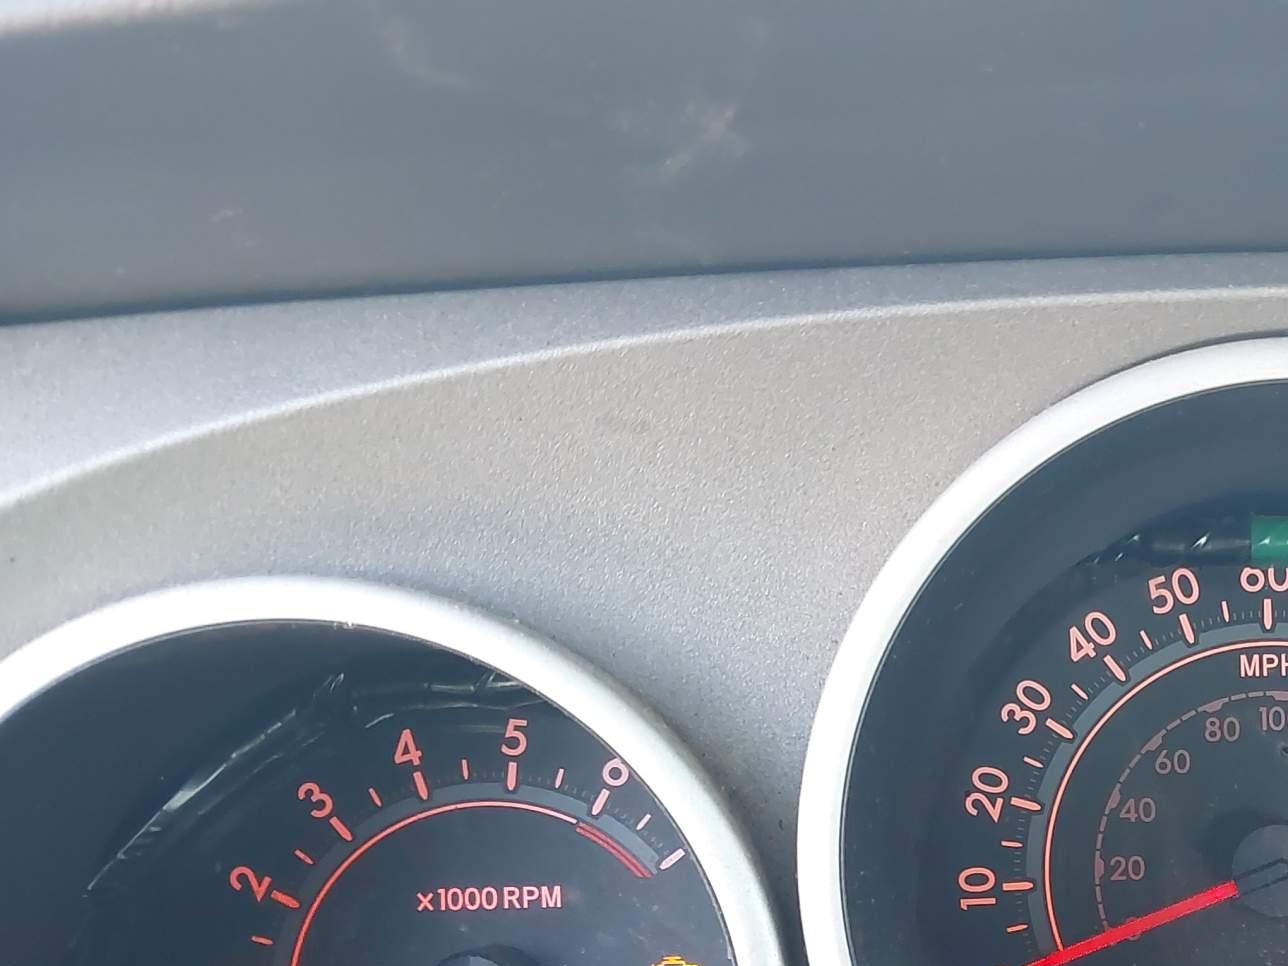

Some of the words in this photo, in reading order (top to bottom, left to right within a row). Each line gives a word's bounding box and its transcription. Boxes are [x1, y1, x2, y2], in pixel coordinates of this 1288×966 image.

[1148, 567, 1201, 616] 50
[1068, 611, 1118, 665] 40
[1001, 679, 1053, 736] 30
[393, 729, 422, 766] 4
[502, 719, 528, 756] 5
[1204, 718, 1241, 742] 80
[1154, 751, 1191, 774] 60
[298, 782, 334, 819] 3
[964, 766, 1010, 822] 20
[1119, 798, 1156, 822] 40
[229, 866, 272, 901] 2
[1110, 856, 1145, 881] 20
[502, 885, 562, 909] RPM
[958, 867, 997, 911] 10
